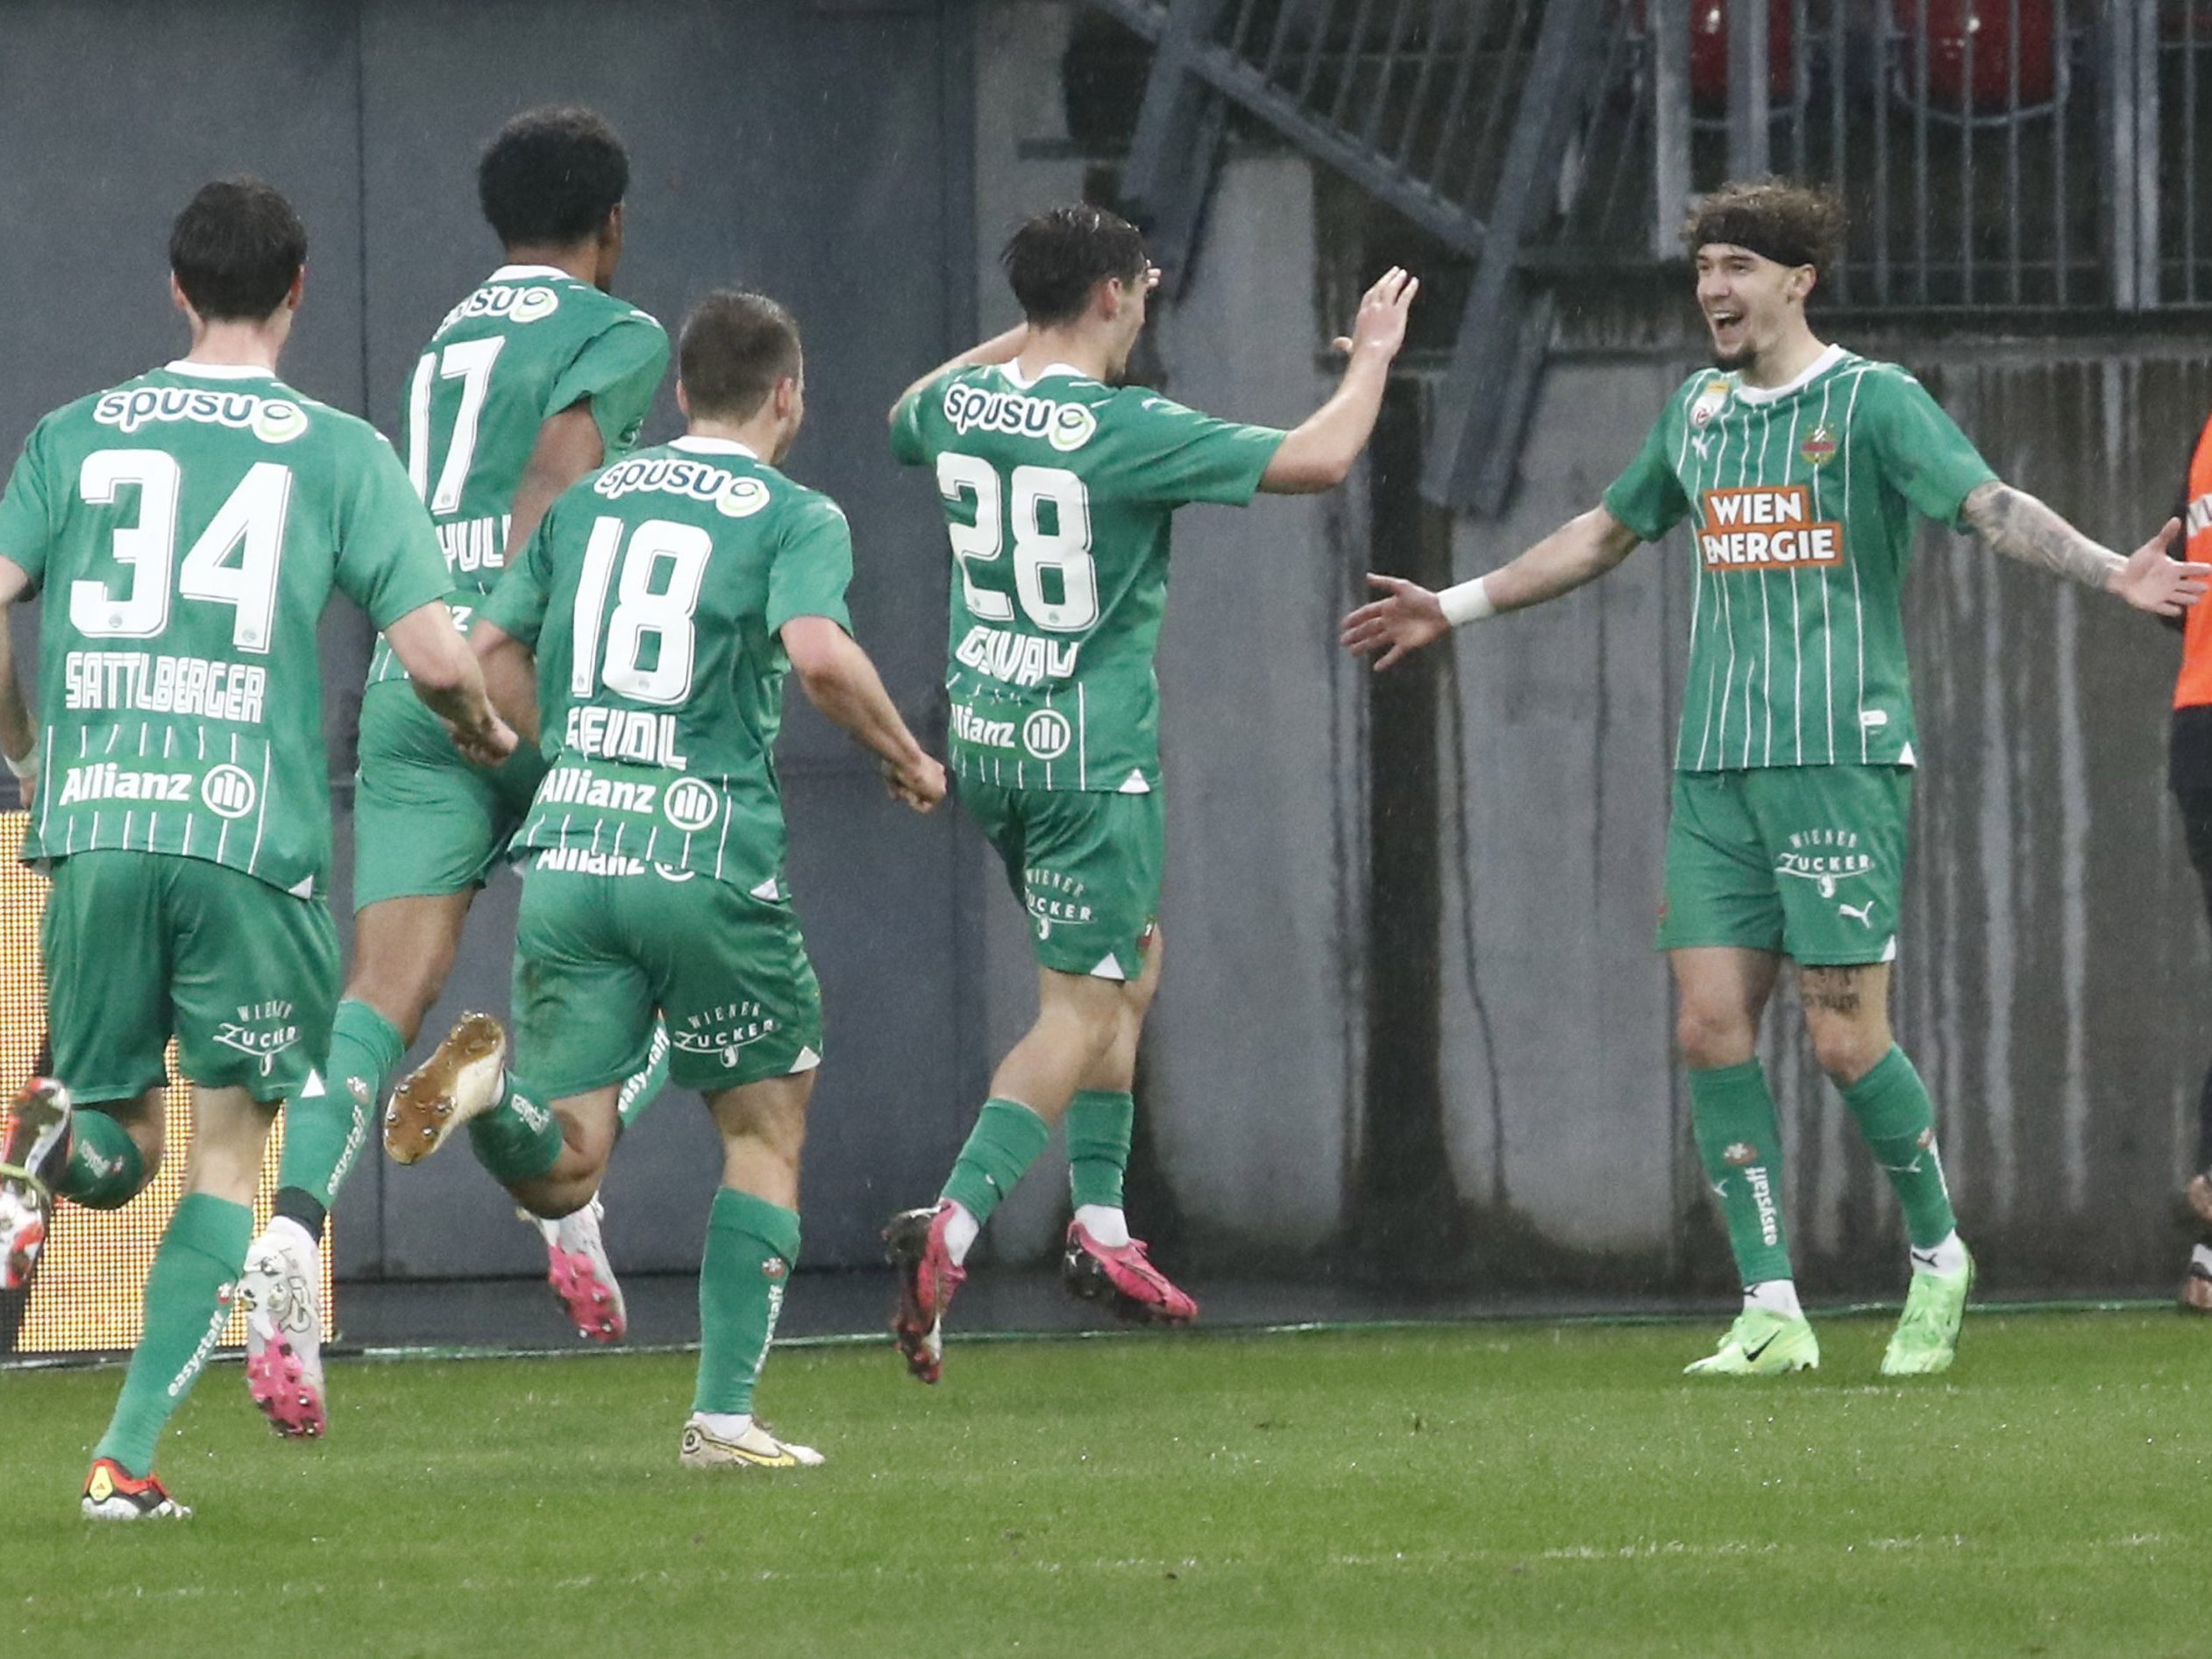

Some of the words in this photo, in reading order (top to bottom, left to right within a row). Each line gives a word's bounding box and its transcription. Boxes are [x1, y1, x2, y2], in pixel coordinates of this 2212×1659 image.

[94, 388, 253, 433] spusu
[409, 336, 506, 516] 17
[944, 383, 1056, 437] spusu
[594, 459, 731, 501] spusu
[1710, 492, 1803, 526] WIEN
[69, 449, 293, 654] 34
[936, 452, 1099, 632] 28
[572, 516, 713, 705] 18
[66, 651, 267, 723] SATTLBERGER
[59, 763, 193, 806] Allianz
[537, 767, 657, 814] Allianz
[672, 1019, 773, 1052] ZUCKER
